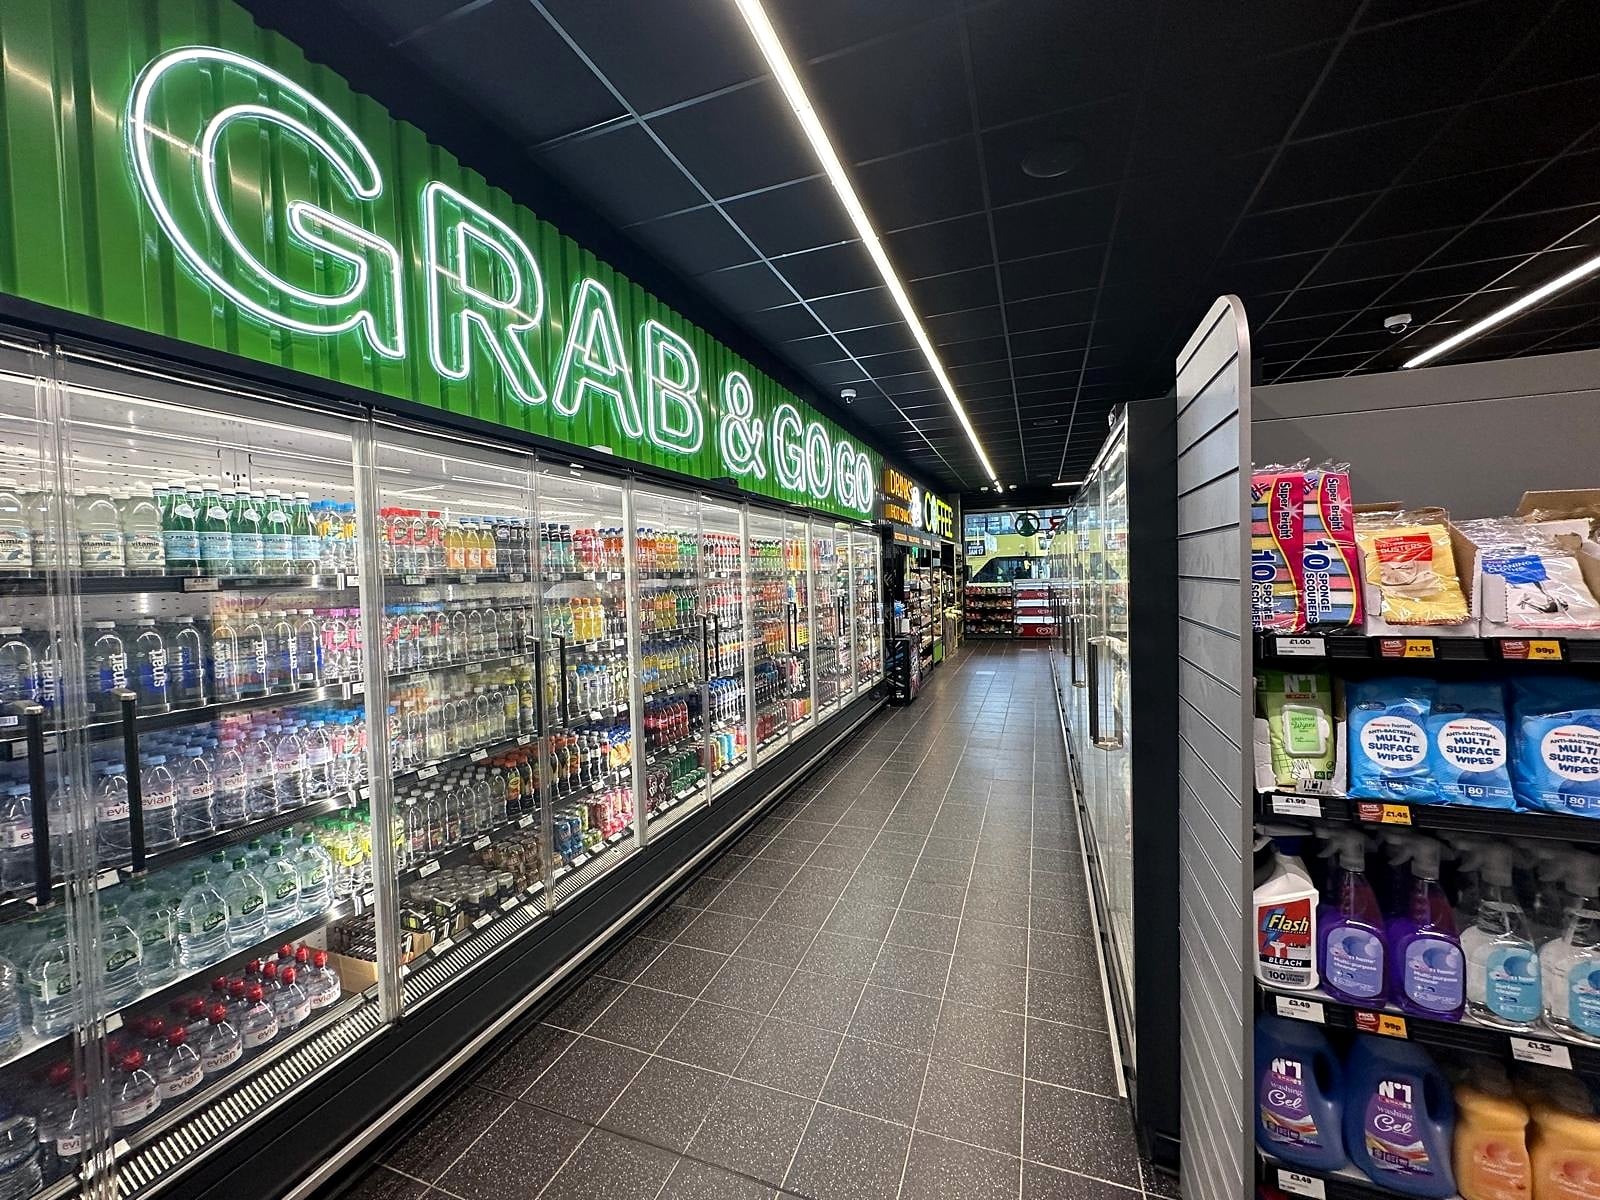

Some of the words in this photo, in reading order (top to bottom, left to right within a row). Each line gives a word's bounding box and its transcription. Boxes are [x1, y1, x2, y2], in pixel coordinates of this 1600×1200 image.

[125, 44, 705, 456] GRAB
[719, 370, 767, 480] &
[772, 403, 833, 499] GO
[835, 441, 873, 514] GO
[1277, 481, 1292, 508] Super
[1325, 478, 1339, 502] Super
[925, 491, 953, 539] COFFEE
[1328, 504, 1344, 531] Bright
[1277, 511, 1293, 540] Bright
[1303, 540, 1331, 571] 10
[1252, 550, 1277, 582] 10
[1304, 571, 1320, 624] SCOURERS
[1318, 571, 1332, 613] SPONGE
[149, 649, 165, 687] smart
[40, 659, 55, 701] smart
[1375, 734, 1411, 743] MULTI
[1454, 736, 1491, 746] MULTI
[1368, 742, 1420, 753] SURFACE
[1446, 745, 1501, 756] SURFACE
[1558, 744, 1598, 756] MULTI
[1377, 752, 1414, 761] WIPES
[1456, 755, 1494, 765] WIPES
[1549, 753, 1600, 765] SURFAC
[1558, 763, 1599, 774] WIPES
[1468, 786, 1483, 795] 80
[141, 794, 171, 806] evian
[1569, 796, 1585, 804] 80
[1268, 913, 1310, 932] Flash
[1268, 957, 1303, 967] BLEACH
[1269, 970, 1286, 980] 100
[312, 991, 337, 1005] evian
[1289, 999, 1311, 1008] £3.49
[257, 1024, 278, 1041] evia
[207, 1050, 236, 1068] evian
[169, 1071, 200, 1091] evian
[1268, 1089, 1303, 1109] Gel
[1374, 1114, 1412, 1134] Gel
